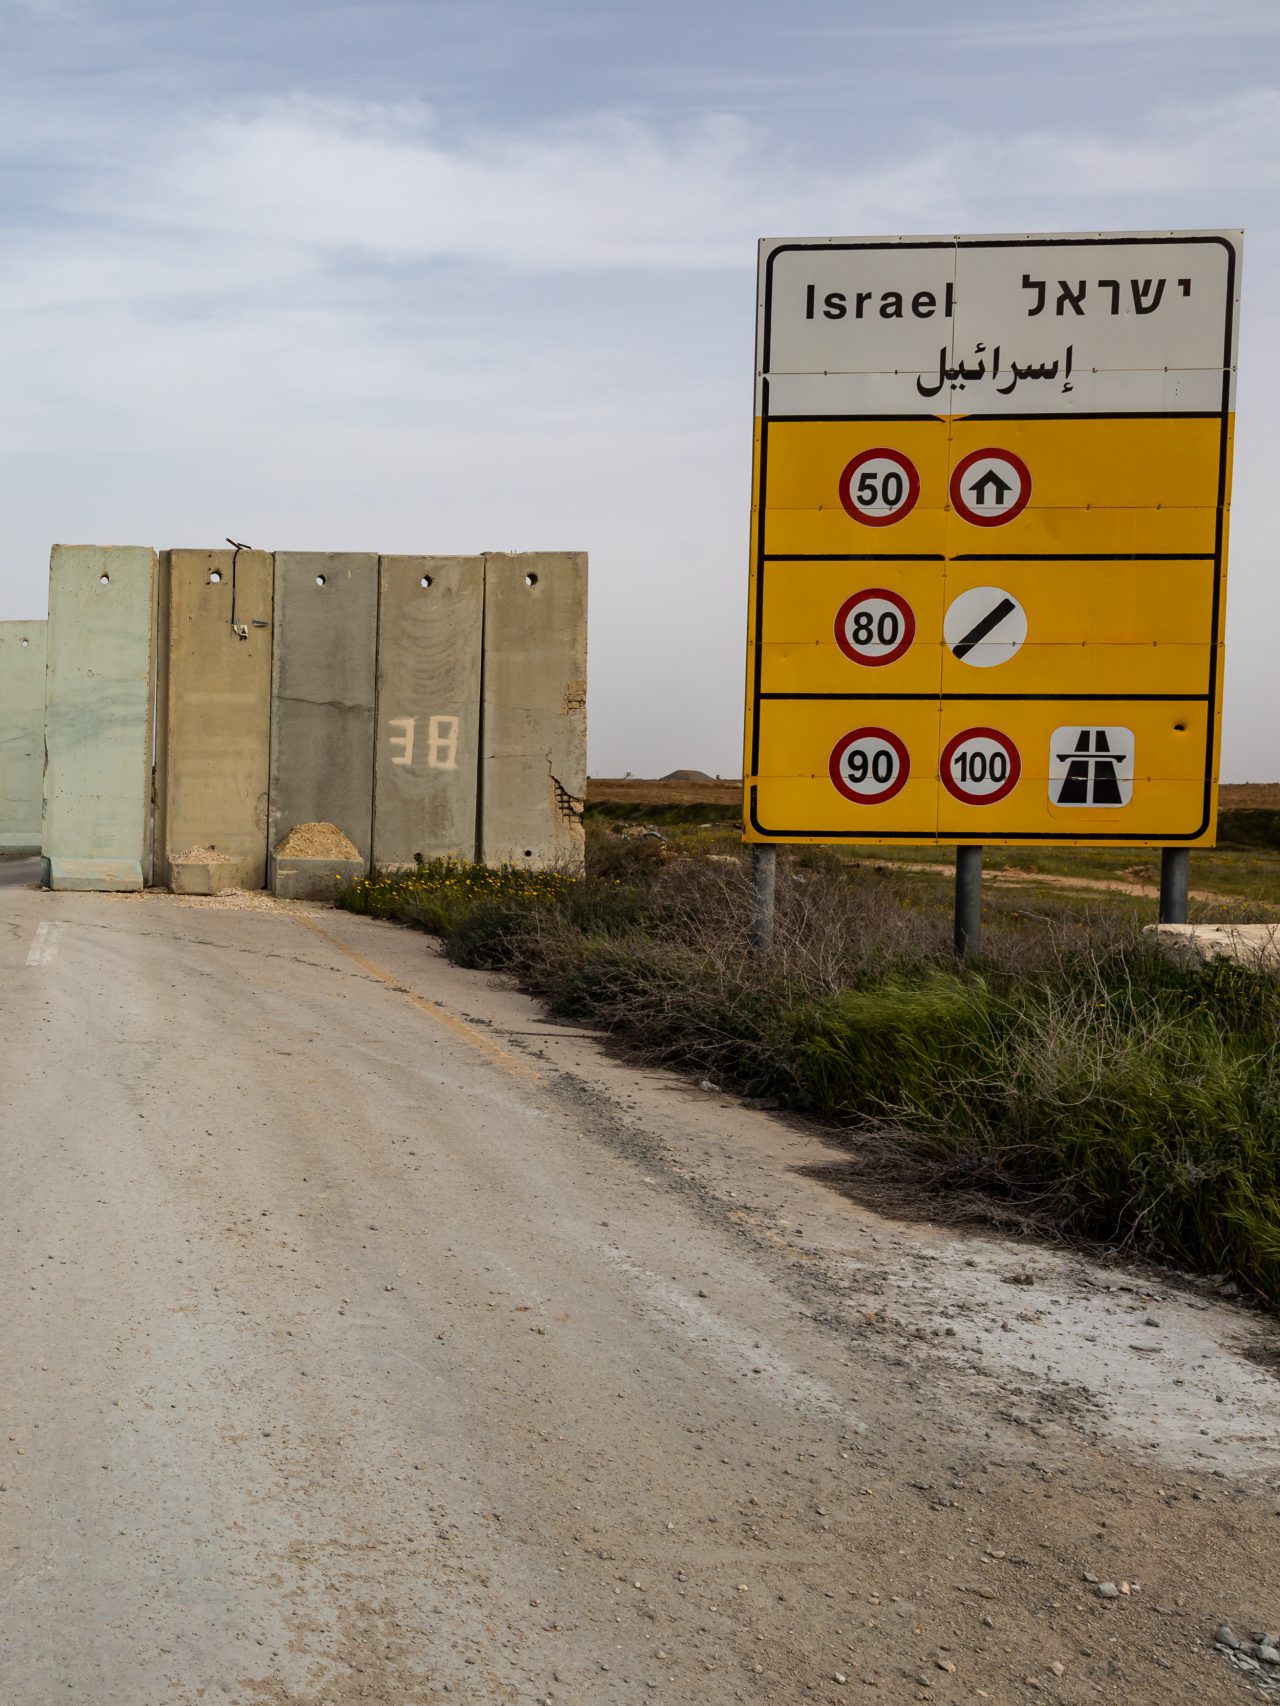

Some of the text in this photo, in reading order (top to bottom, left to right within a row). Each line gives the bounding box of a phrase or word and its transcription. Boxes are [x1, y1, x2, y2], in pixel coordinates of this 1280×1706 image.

[804, 281, 955, 320] Israel
[1021, 273, 1193, 317] ישראל
[916, 342, 1074, 398] إسرائيل
[856, 471, 903, 506] 50
[852, 611, 899, 646] 80
[388, 715, 459, 769] 38
[847, 749, 894, 784] 90
[954, 751, 1007, 783] 100
